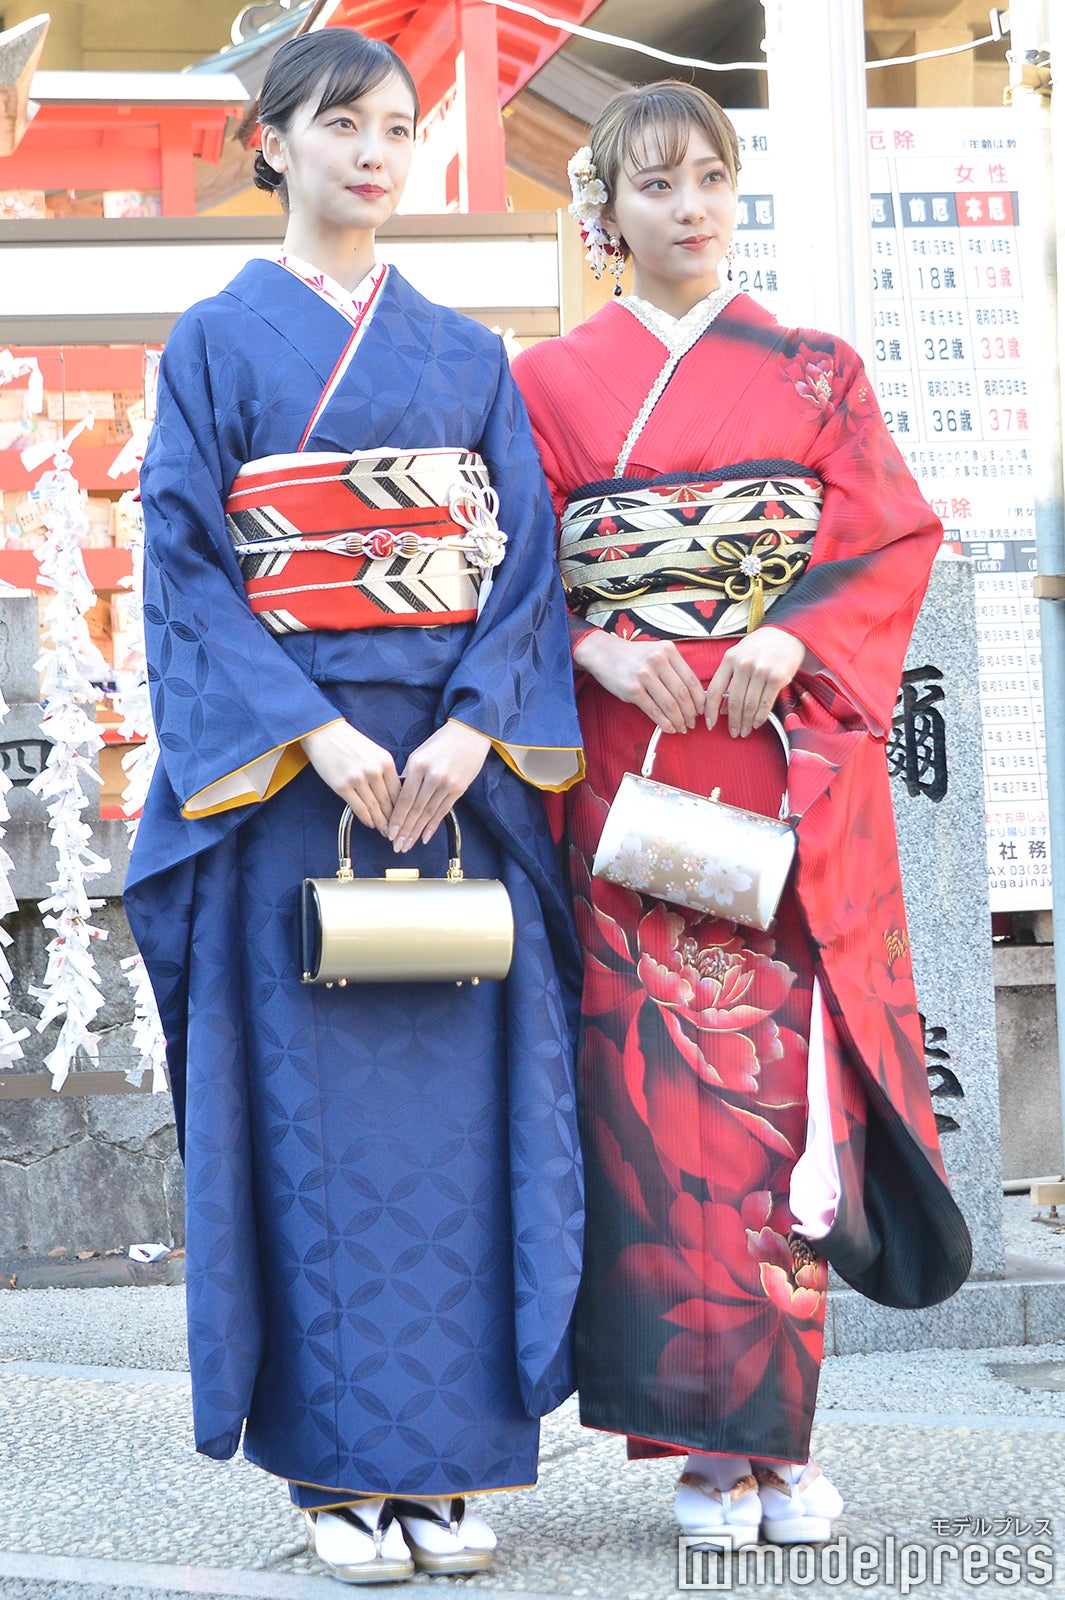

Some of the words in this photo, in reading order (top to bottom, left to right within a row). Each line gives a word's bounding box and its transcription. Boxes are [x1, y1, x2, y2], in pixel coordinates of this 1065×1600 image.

[954, 163, 1008, 184] 女性
[908, 198, 950, 223] 前厄
[964, 197, 1006, 222] 本厄
[739, 270, 778, 292] 24歳
[918, 267, 956, 290] 18歳
[974, 266, 1013, 289] 19歳
[924, 338, 965, 360] 32歳
[980, 336, 1021, 360] 33歳
[932, 408, 973, 432] 36歳
[989, 407, 1029, 431] 37歳
[998, 840, 1047, 861] 社務
